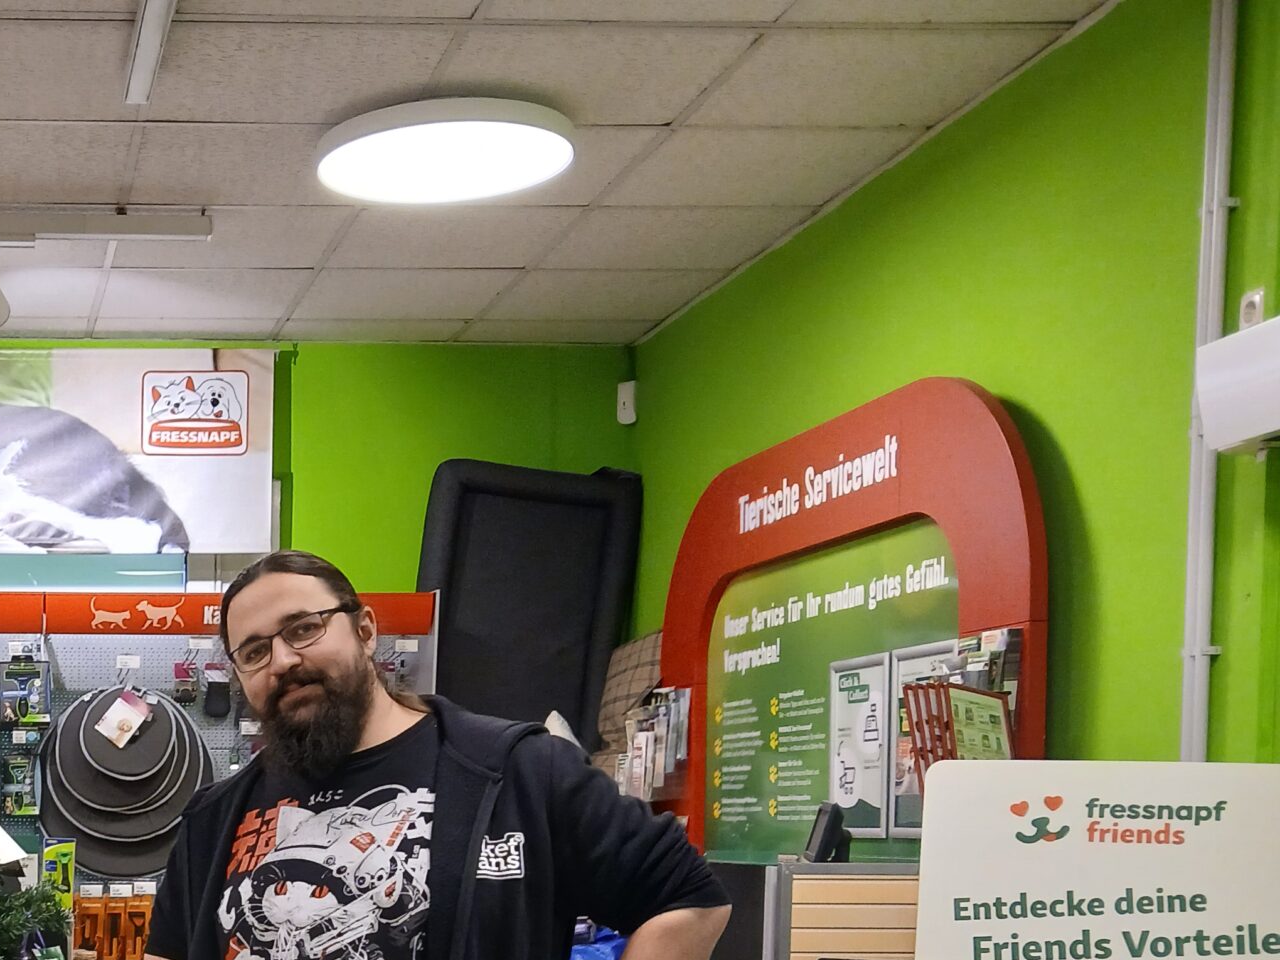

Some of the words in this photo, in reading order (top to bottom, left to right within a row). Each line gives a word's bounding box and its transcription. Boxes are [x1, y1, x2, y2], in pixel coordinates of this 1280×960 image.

[151, 429, 240, 447] FRESSNAPF
[737, 478, 800, 535] Tierische
[804, 434, 898, 507] Servicewelt
[724, 614, 749, 639] Unser
[751, 602, 785, 632] Service
[787, 597, 803, 623] für
[806, 592, 821, 618] Ihr
[824, 582, 864, 614] rundum
[869, 574, 901, 610] gutes
[906, 556, 949, 594] Gefühl.
[724, 638, 781, 675] Versprochen!
[1085, 798, 1228, 826] fressnapf
[481, 837, 520, 857] ket
[1086, 821, 1186, 846] friends
[478, 855, 520, 870] ans
[953, 889, 1105, 922] Entdecke
[1114, 889, 1208, 917] deine
[1122, 924, 1280, 959] Vorteile
